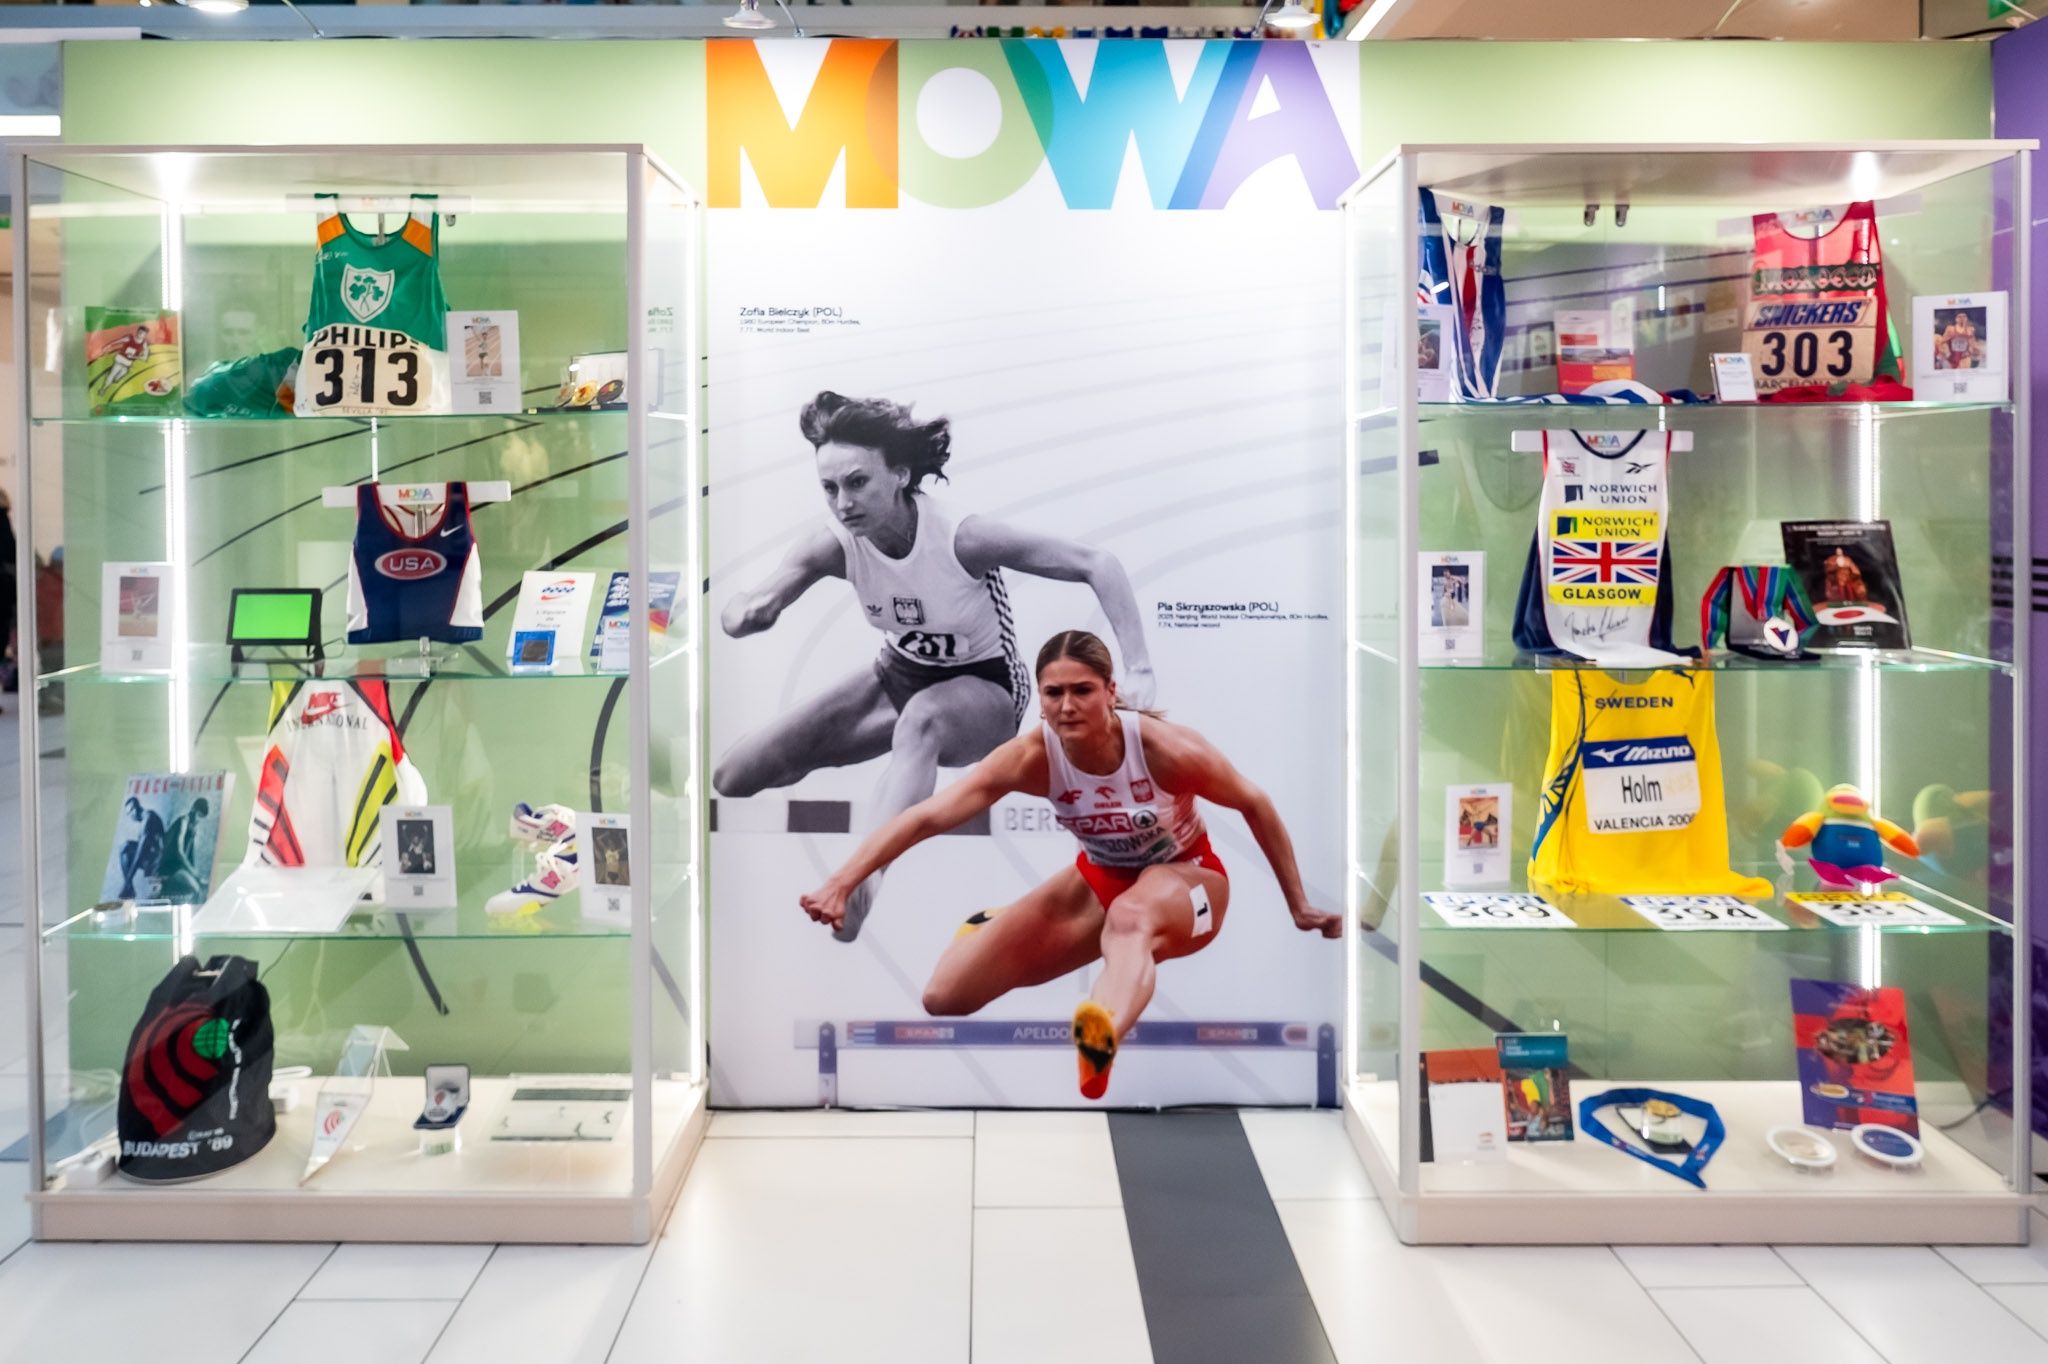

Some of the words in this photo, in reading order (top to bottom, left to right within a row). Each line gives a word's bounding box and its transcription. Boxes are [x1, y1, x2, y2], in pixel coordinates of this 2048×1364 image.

[706, 39, 1360, 210] MOWA
[740, 307, 765, 316] Zofia
[768, 307, 809, 318] Bielczyk
[813, 307, 842, 317] (POL)
[1754, 302, 1862, 327] SNICKERS
[1761, 330, 1853, 378] 303
[315, 347, 418, 407] 313
[1589, 484, 1657, 493] NORWICH
[1600, 495, 1647, 504] UNION
[1582, 516, 1654, 526] NORWICH
[1595, 528, 1640, 537] UNION
[389, 556, 435, 571] USA
[1563, 588, 1642, 600] GLASGOW
[1157, 602, 1173, 611] Pia
[1176, 602, 1246, 613] Skrzyszowska
[1249, 602, 1279, 612] (POL)
[1595, 697, 1674, 709] SWEDEN
[1621, 774, 1663, 804] Holm
[1594, 815, 1665, 831] VALENCIA
[123, 1140, 200, 1159] BUDAPEST
[207, 1134, 234, 1152] '89
